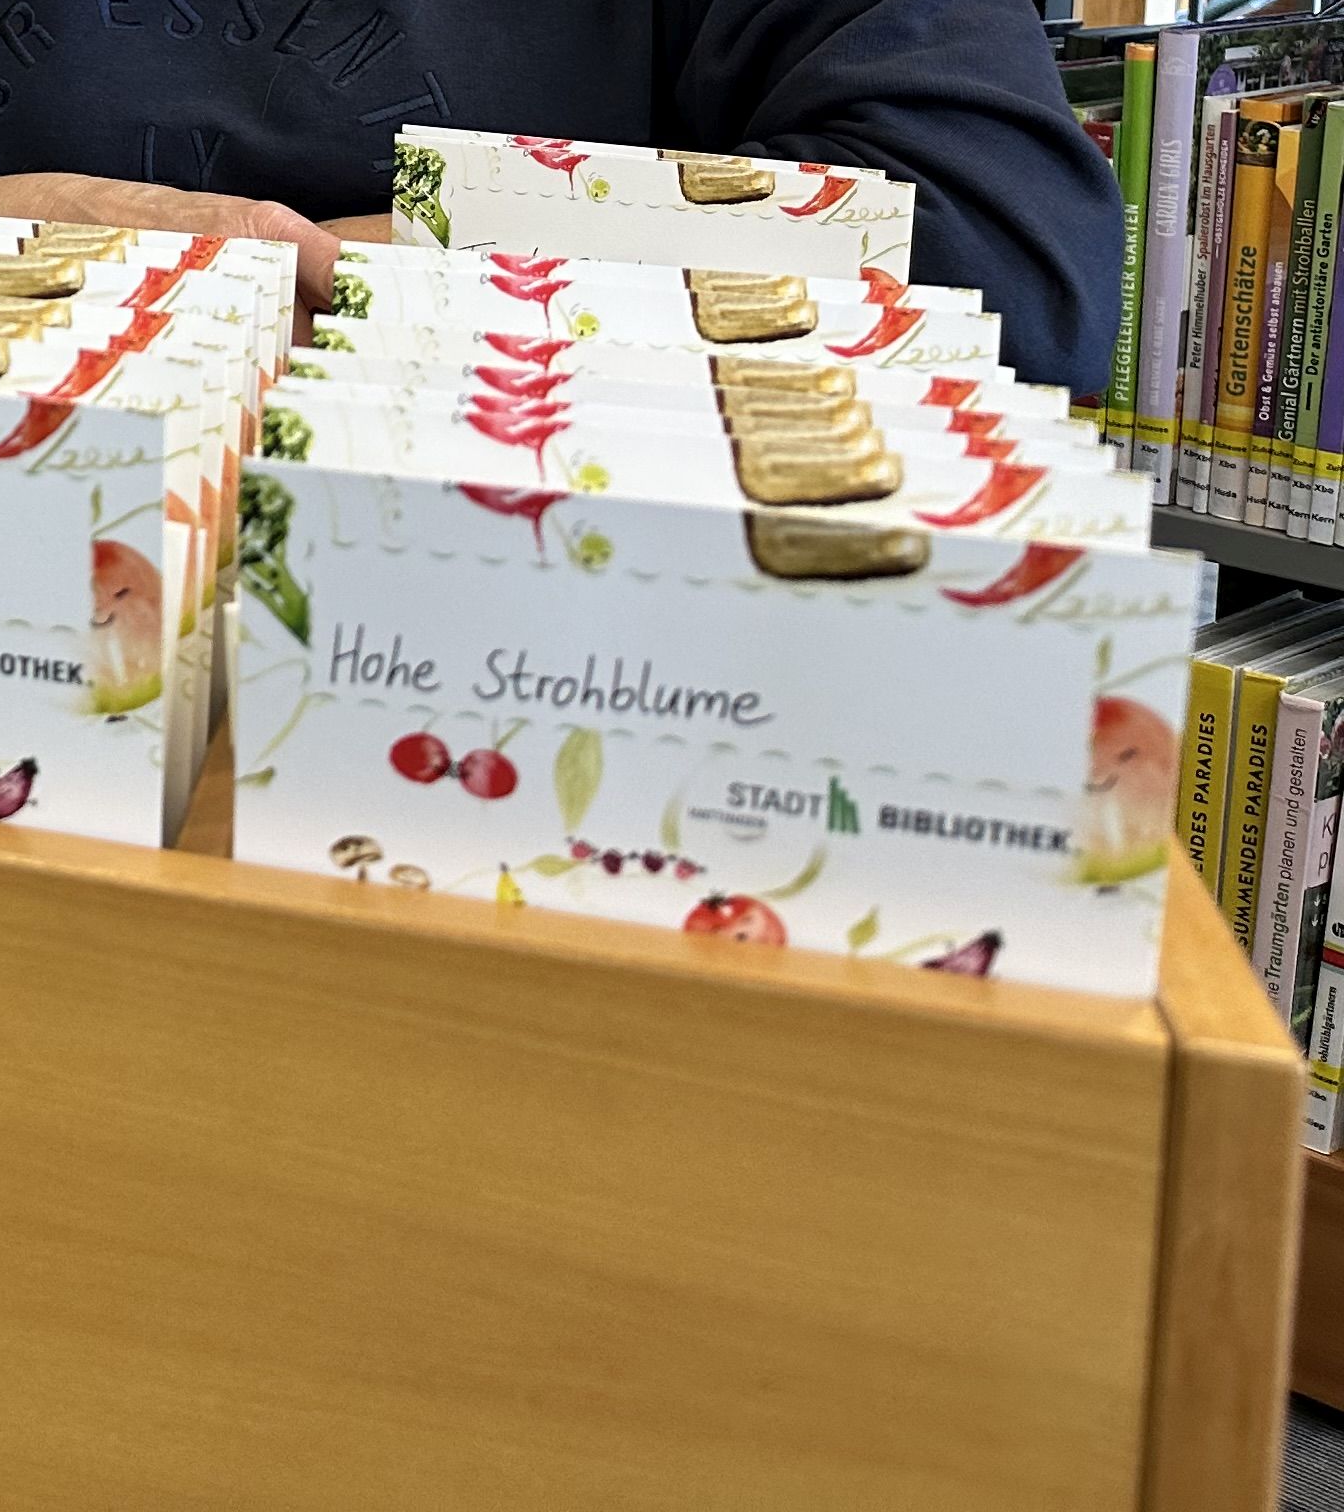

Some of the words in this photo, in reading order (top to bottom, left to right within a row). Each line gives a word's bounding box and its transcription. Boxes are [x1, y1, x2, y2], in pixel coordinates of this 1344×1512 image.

[1159, 139, 1182, 178] GIRLS
[1202, 124, 1217, 185] Hausgarten
[1155, 183, 1179, 237] GARDEN
[1202, 188, 1211, 200] im
[1124, 203, 1139, 265] GARTEN
[1197, 201, 1212, 261] Spalierobst
[1292, 199, 1315, 288] Strohballen
[1316, 213, 1333, 256] Garten
[1191, 269, 1207, 339] Himmelhuber
[1272, 262, 1285, 305] anbauen
[1293, 290, 1306, 315] mit
[1311, 261, 1329, 351] antiautoritäre
[1114, 271, 1136, 401] PFLEGELEICHTER
[1226, 245, 1258, 396] Gartenschätze
[1269, 307, 1280, 339] selbst
[1189, 343, 1202, 369] Peter
[1262, 340, 1276, 382] Gemüse
[1283, 317, 1305, 389] Gärtnern
[1305, 354, 1319, 376] Der
[1259, 397, 1271, 421] Obst
[1262, 381, 1272, 393] &
[1278, 390, 1297, 442] Genial
[328, 622, 441, 691] Hohe
[471, 648, 776, 729] Strohblume
[1194, 712, 1216, 805] PARADIES
[1248, 724, 1268, 816] PARADIES
[1289, 728, 1308, 796] gestalten
[727, 781, 824, 818] STADT
[1285, 799, 1300, 826] und
[1190, 811, 1208, 873] ENDES
[1280, 832, 1296, 881] planen
[1265, 882, 1290, 981] Traumgärten
[1321, 986, 1337, 1063] ohlfühlgärtnern
